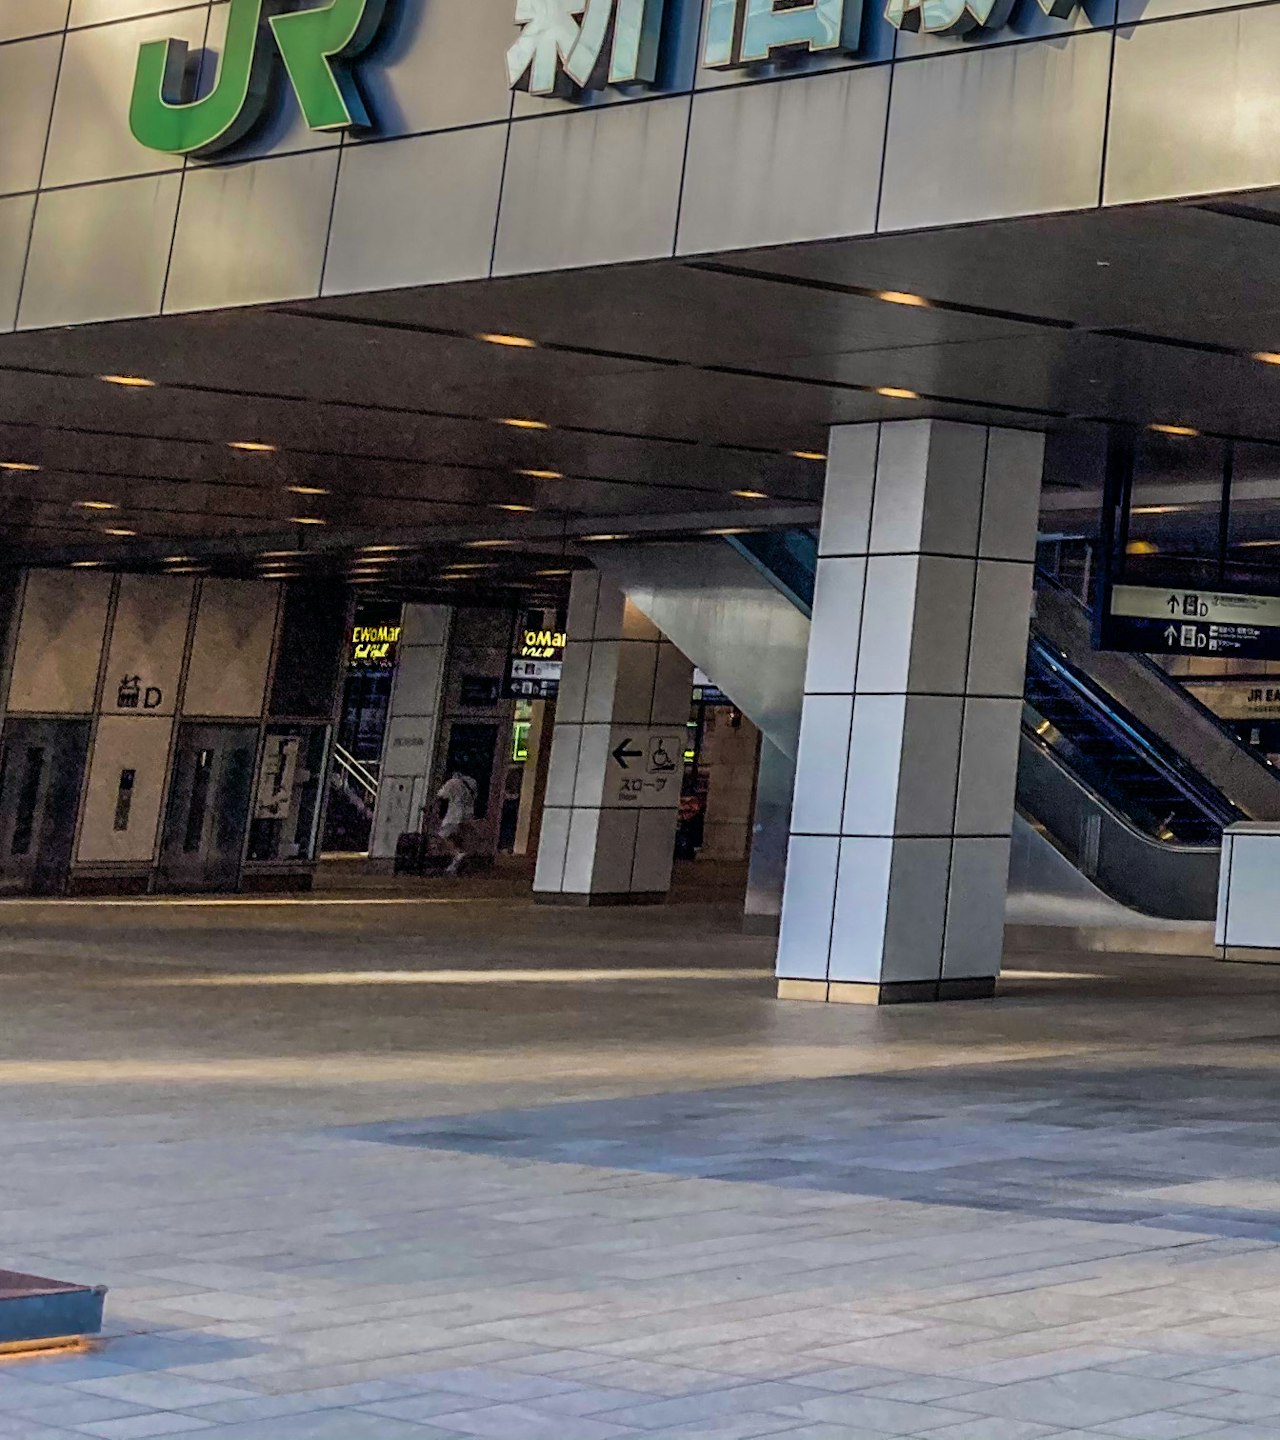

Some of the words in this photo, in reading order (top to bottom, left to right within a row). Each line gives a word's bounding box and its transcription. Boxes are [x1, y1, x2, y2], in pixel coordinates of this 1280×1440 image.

[1200, 603, 1208, 617] D
[1197, 633, 1207, 648] D
[144, 686, 162, 708] D
[1248, 689, 1262, 701] JR
